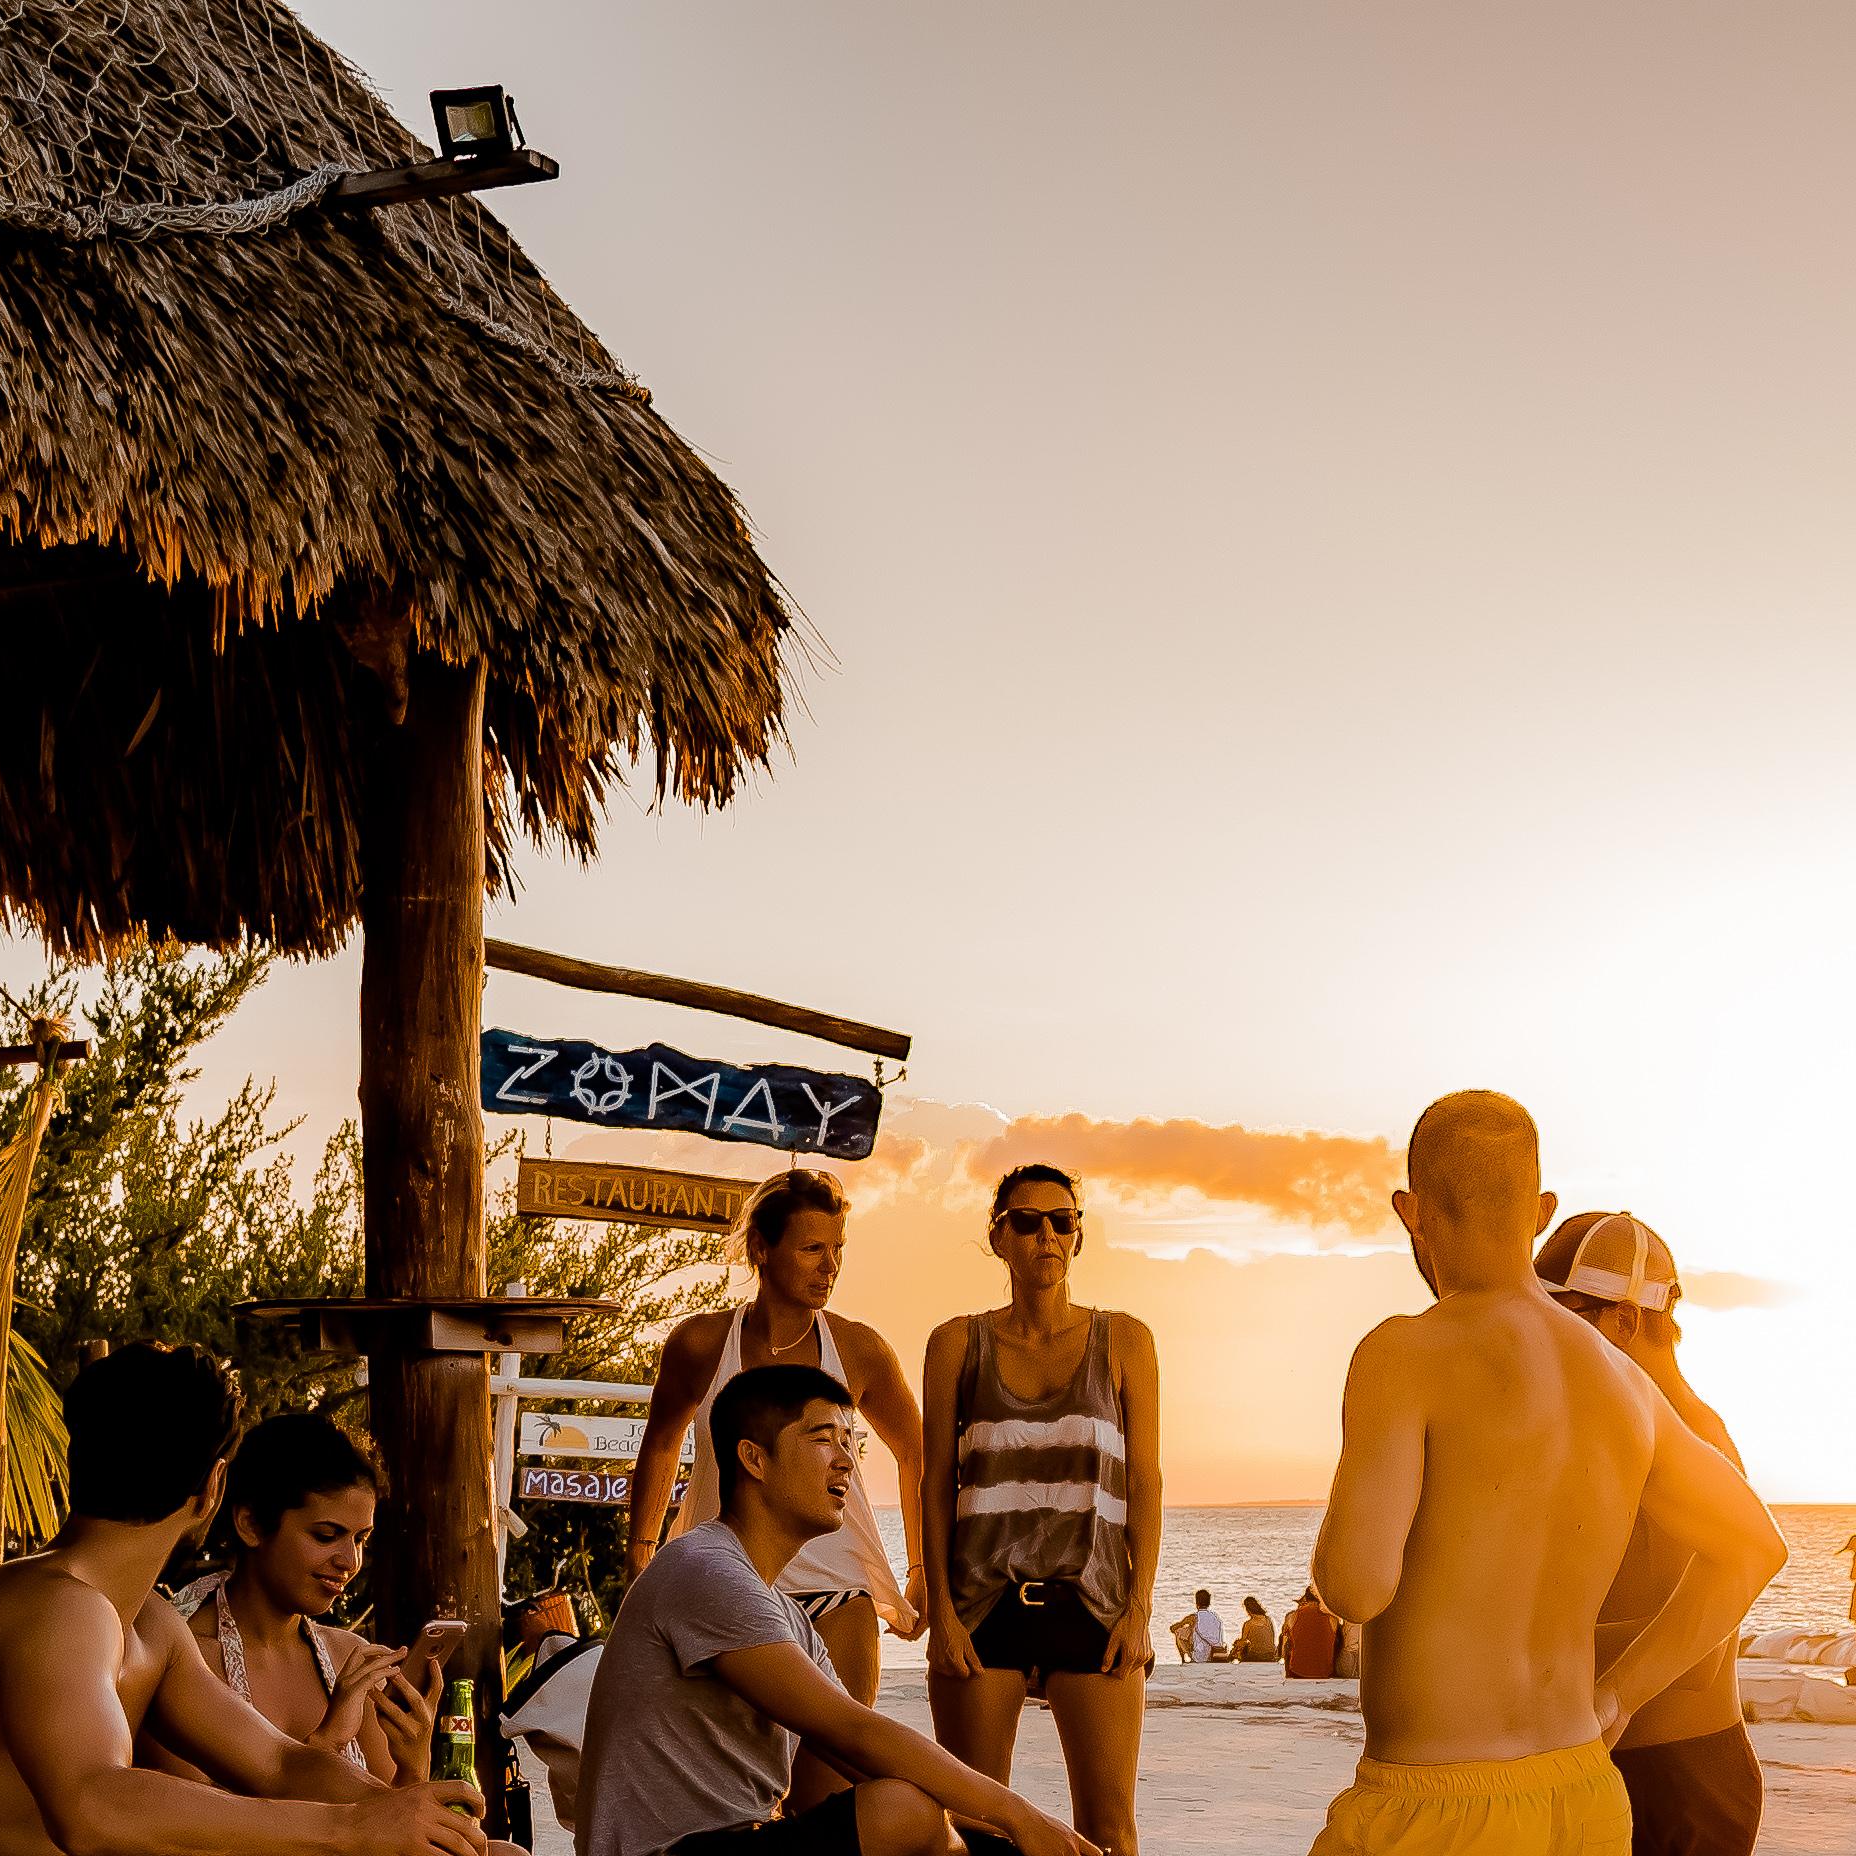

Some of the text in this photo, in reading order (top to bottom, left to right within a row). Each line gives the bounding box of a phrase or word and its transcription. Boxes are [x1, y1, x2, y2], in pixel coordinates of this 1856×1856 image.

[495, 1043, 862, 1147] ZOMAY
[532, 1170, 743, 1220] RESTAURANT
[593, 1436, 641, 1453] Beac
[525, 1472, 627, 1502] Masaje
